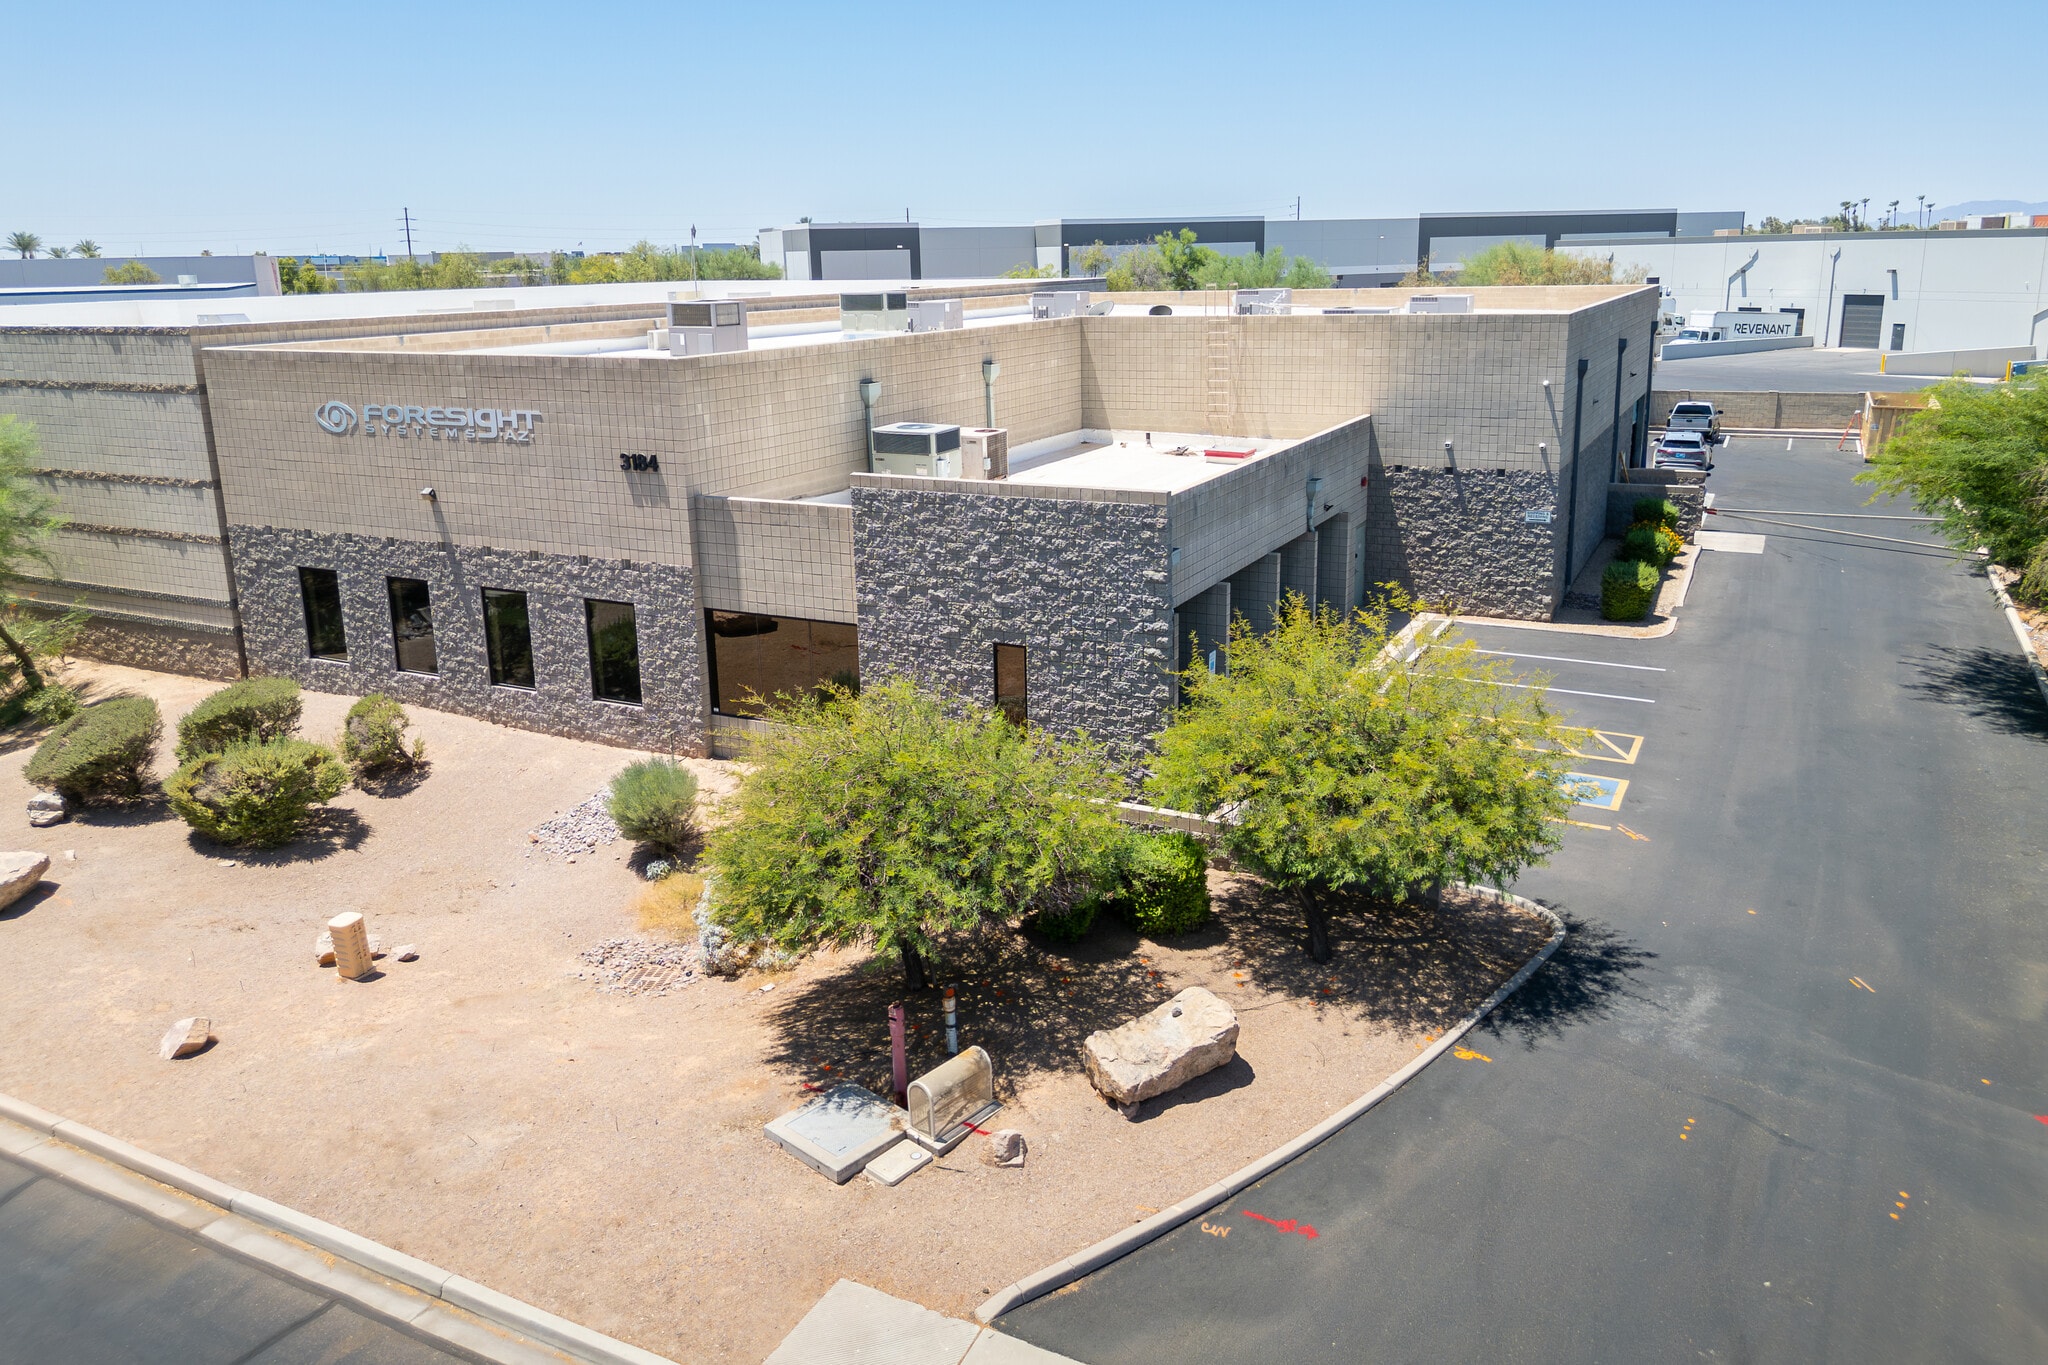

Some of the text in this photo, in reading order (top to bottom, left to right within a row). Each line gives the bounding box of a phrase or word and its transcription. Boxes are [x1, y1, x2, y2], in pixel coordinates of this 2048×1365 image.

[1734, 323, 1791, 335] REVENANT
[365, 424, 475, 439] SYSTEMS
[620, 453, 659, 472] 3184
